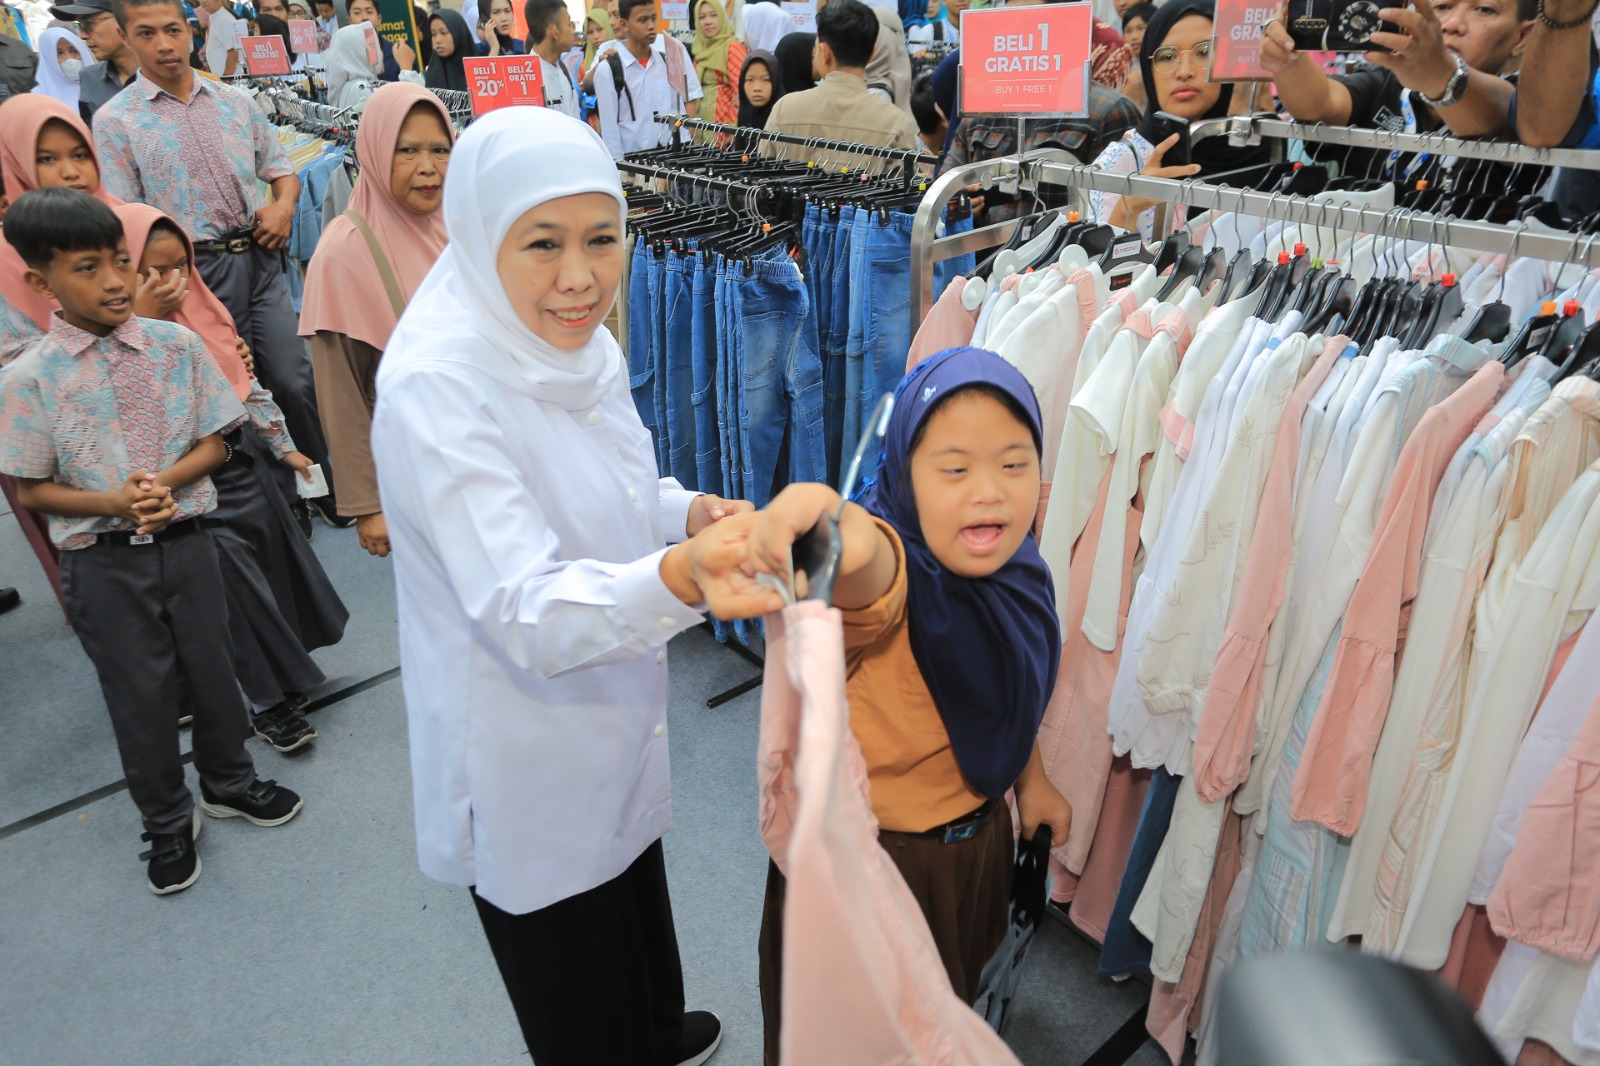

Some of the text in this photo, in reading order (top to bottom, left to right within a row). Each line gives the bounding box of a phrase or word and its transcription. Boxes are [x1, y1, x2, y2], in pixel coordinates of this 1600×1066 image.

[377, 20, 405, 32] emat
[1230, 24, 1263, 40] GRA
[994, 23, 1049, 52] BELI 1
[254, 44, 268, 52] BELI
[252, 51, 276, 59] GRATIS
[474, 62, 496, 75] BELI 1
[508, 61, 533, 74] BELI 2
[984, 54, 1061, 73] GRATIS 1
[509, 74, 536, 82] GRATIS
[476, 80, 504, 97] 20%
[521, 81, 528, 95] 1
[996, 84, 1053, 94] BUY 1 FREE 1
